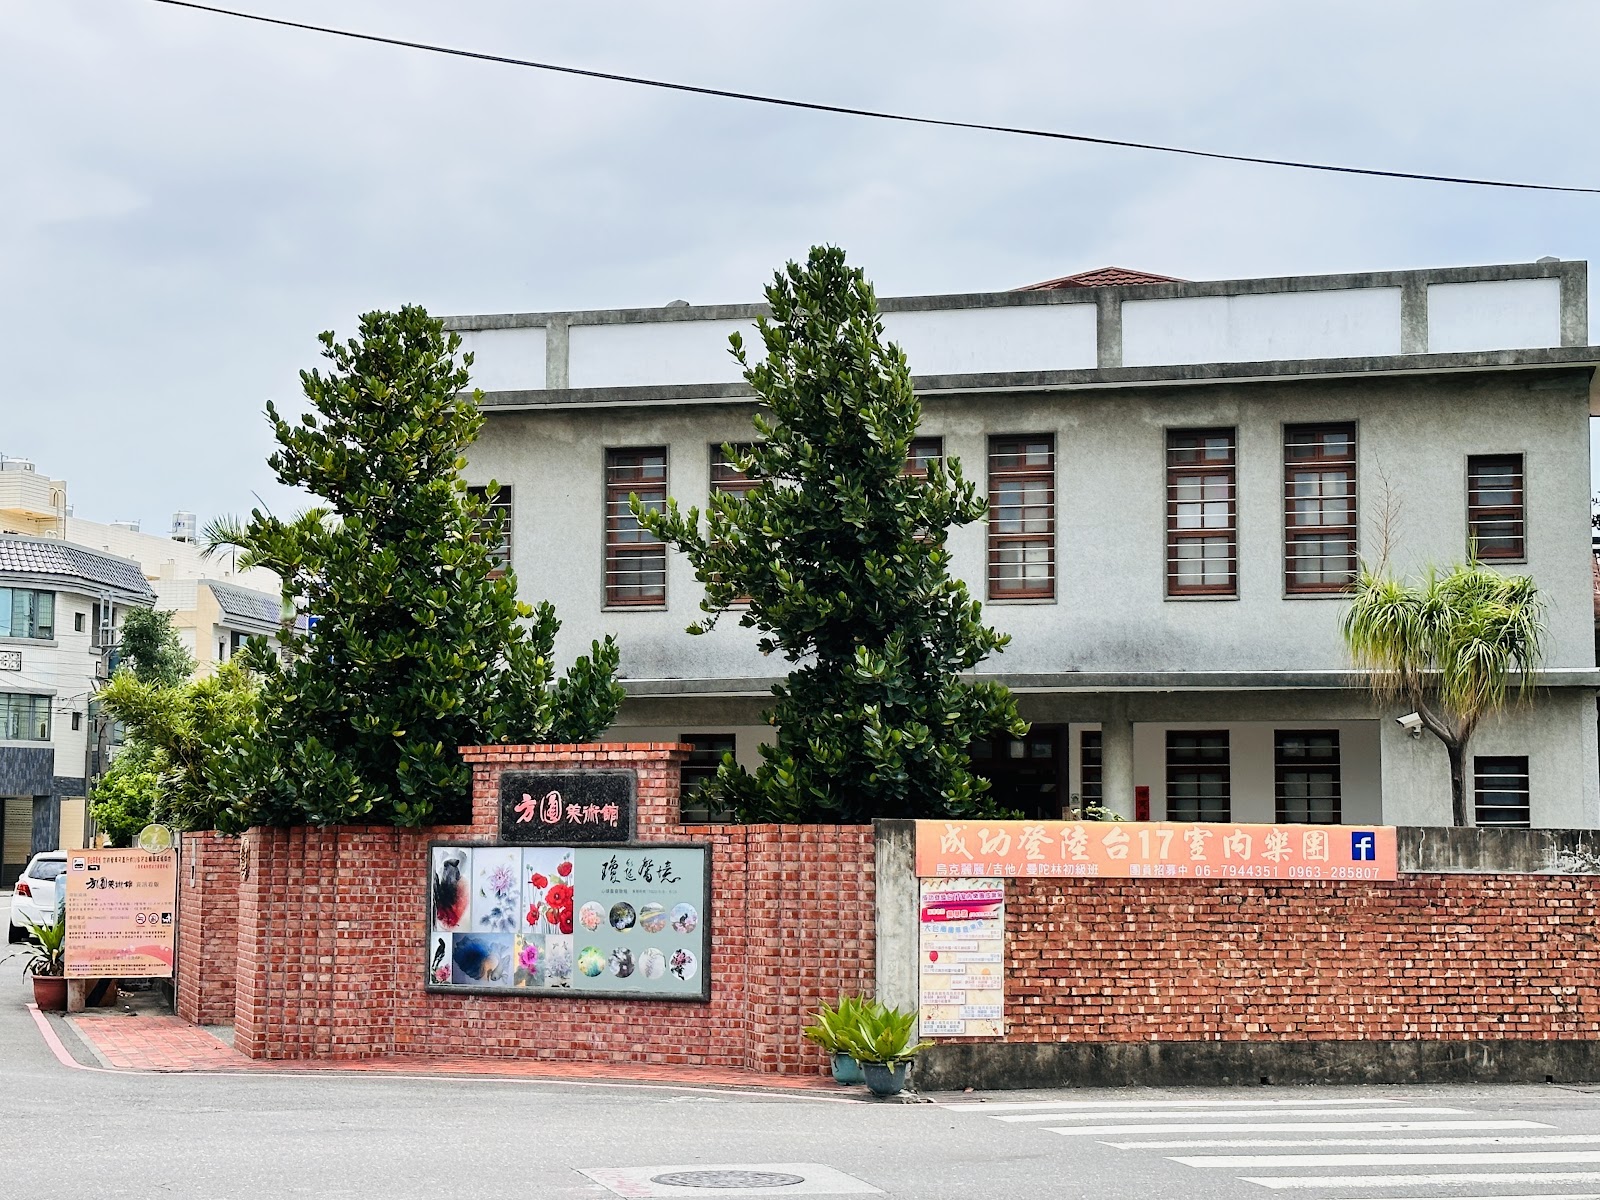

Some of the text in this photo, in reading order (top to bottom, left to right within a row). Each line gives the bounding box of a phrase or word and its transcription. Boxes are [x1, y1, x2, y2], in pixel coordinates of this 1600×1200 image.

[514, 790, 619, 827] 方圓美術館
[940, 824, 1330, 862] 成功登陸台17室內樂團
[1129, 864, 1187, 877] 團員招募中
[1194, 865, 1279, 878] 06-7944351
[1288, 866, 1380, 880] 0963-285807
